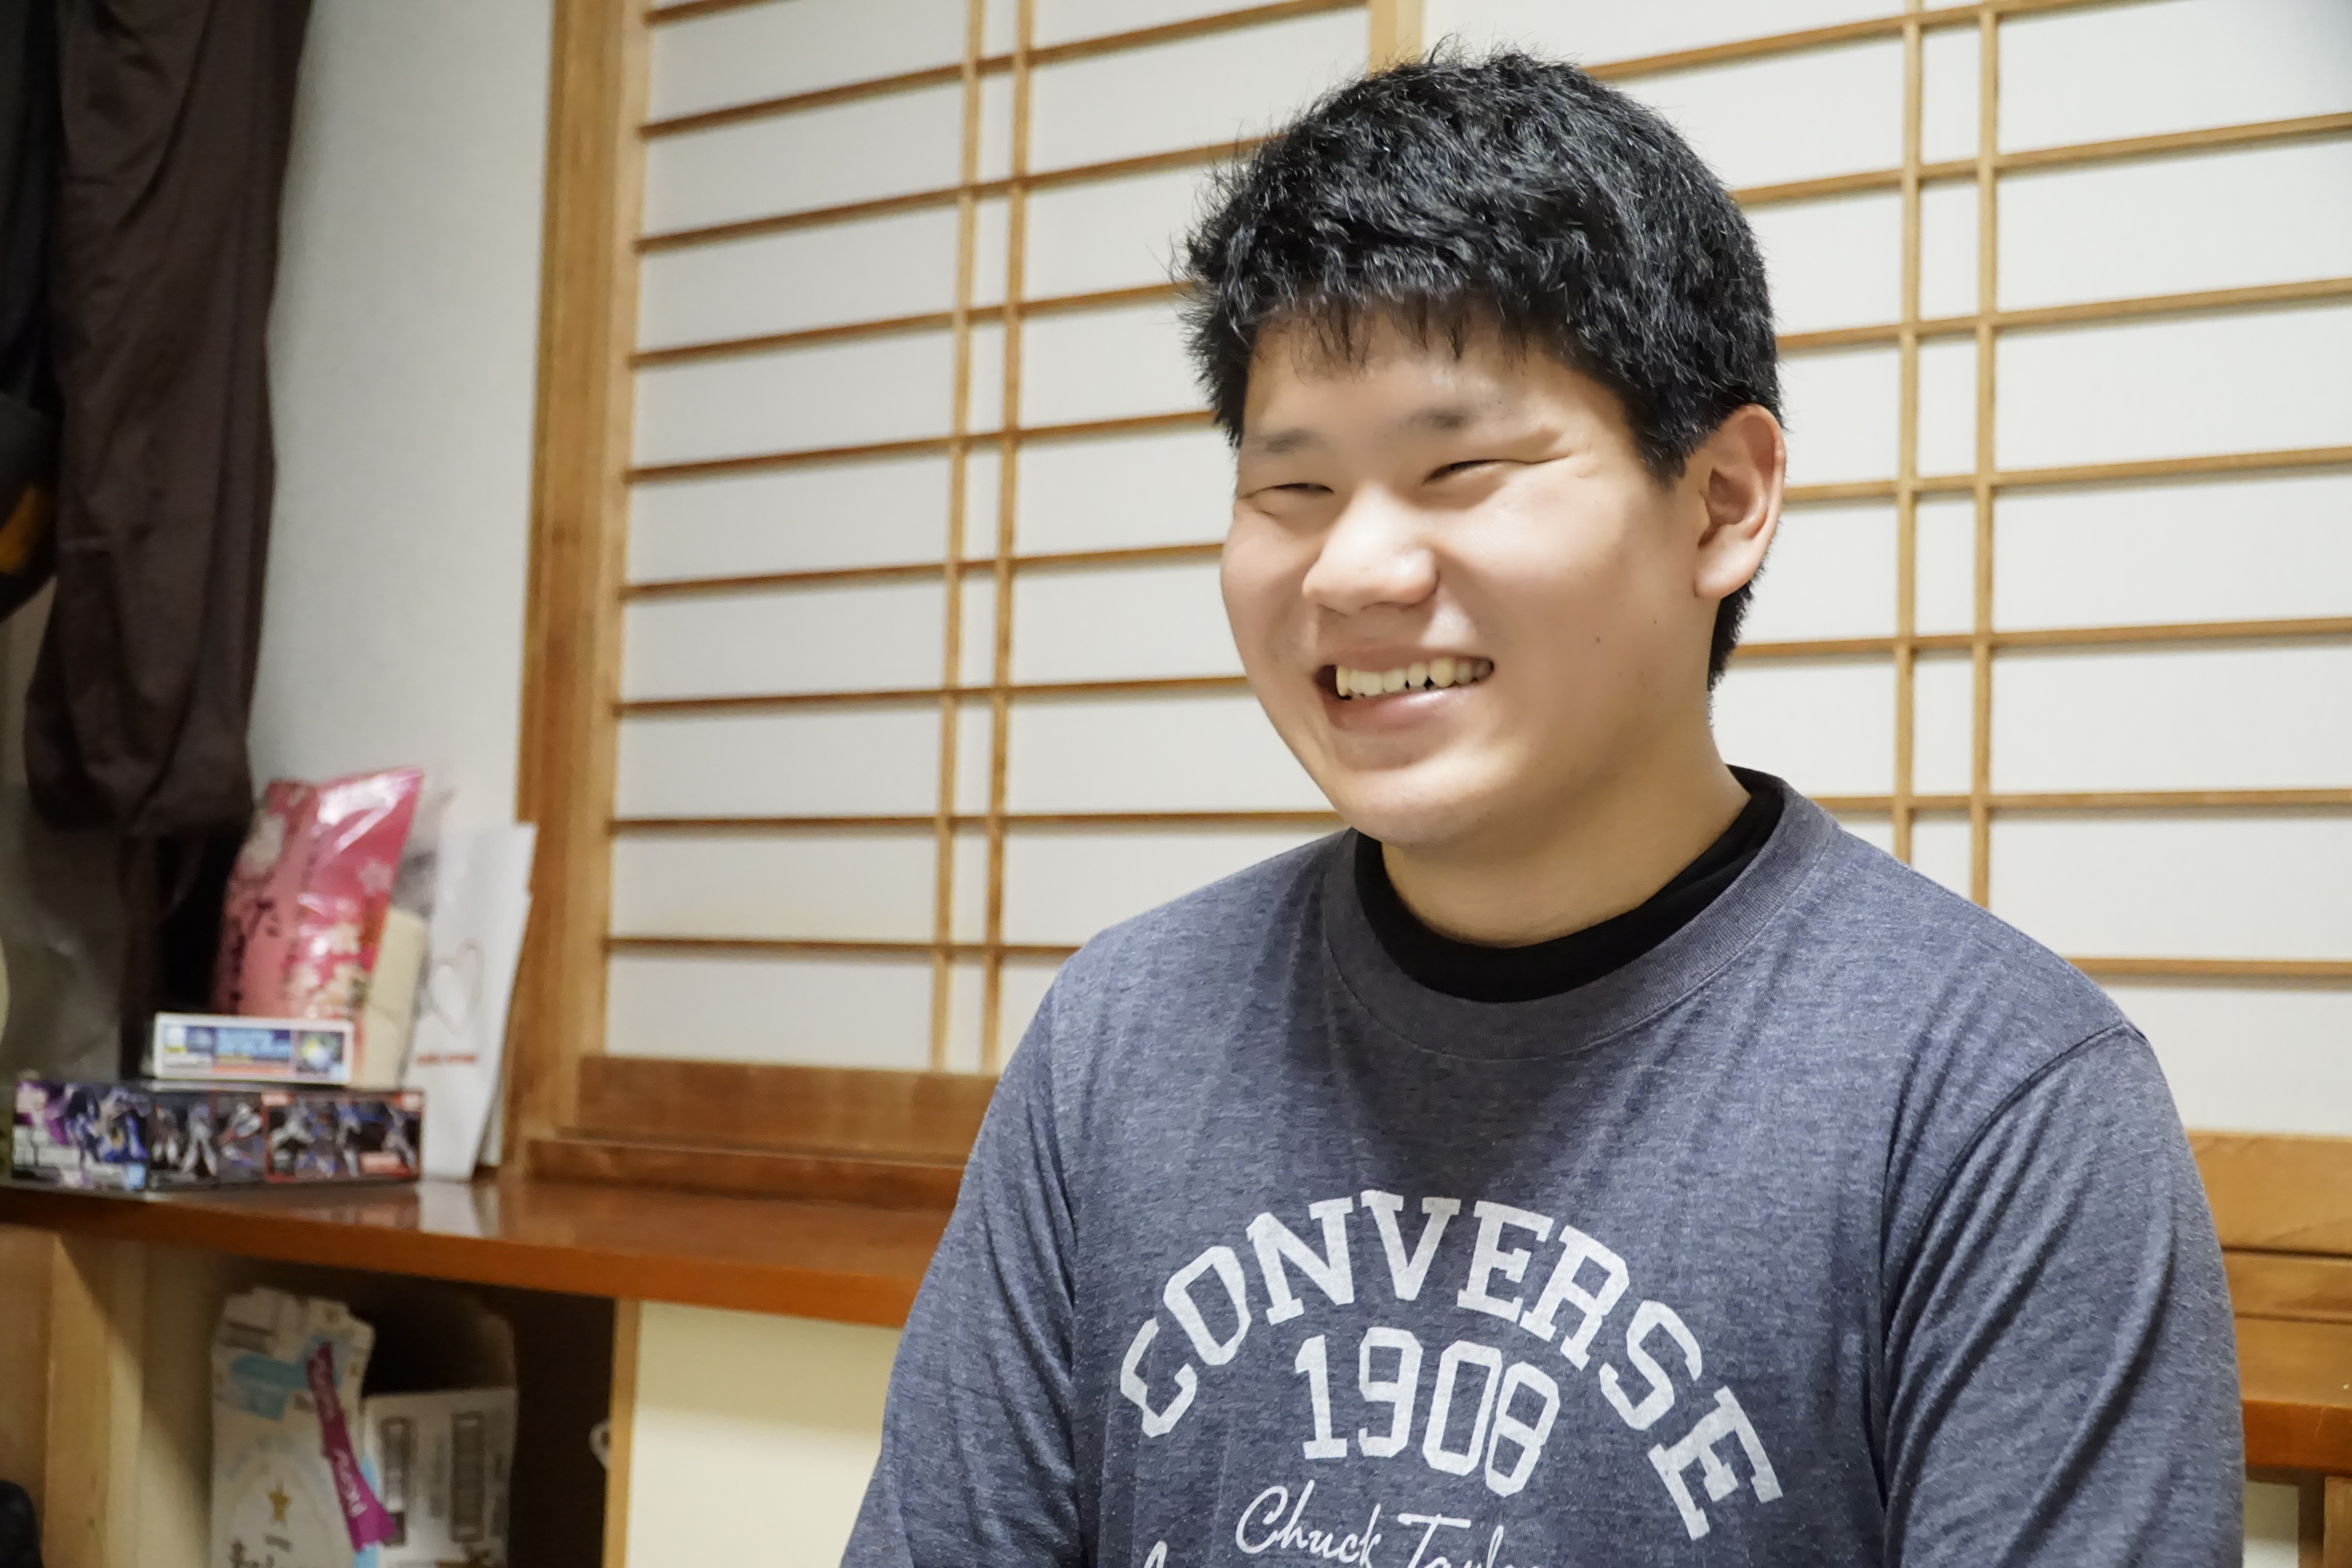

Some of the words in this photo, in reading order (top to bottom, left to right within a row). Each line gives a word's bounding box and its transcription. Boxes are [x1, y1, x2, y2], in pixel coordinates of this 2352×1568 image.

[1120, 1189, 1784, 1540] CONVERSE
[1294, 1327, 1560, 1498] 1908
[1235, 1479, 1382, 1568] Chuck
